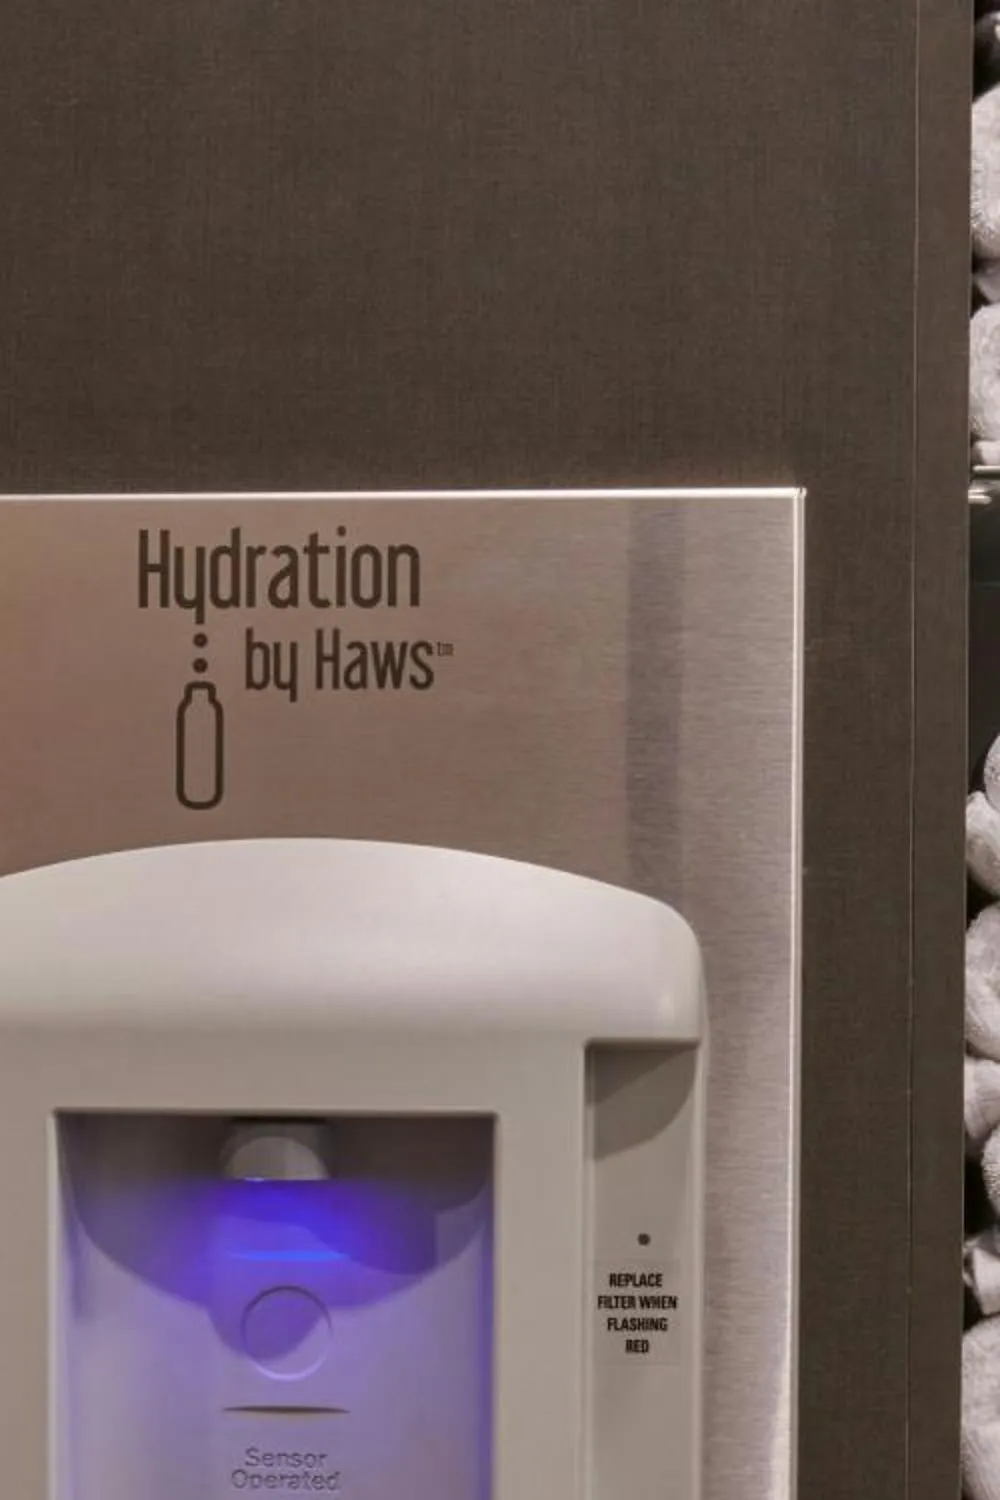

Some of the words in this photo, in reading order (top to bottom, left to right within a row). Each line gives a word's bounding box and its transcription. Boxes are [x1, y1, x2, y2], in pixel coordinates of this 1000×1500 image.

[138, 526, 420, 624] Hydration
[245, 627, 298, 702] by
[609, 1273, 663, 1287] REPLACE
[598, 1296, 636, 1309] FILTER
[639, 1296, 678, 1309] WHEN
[607, 1317, 668, 1331] FLASHING
[625, 1339, 650, 1353] RED
[244, 1446, 328, 1468] Sensor
[230, 1468, 342, 1491] Operated
